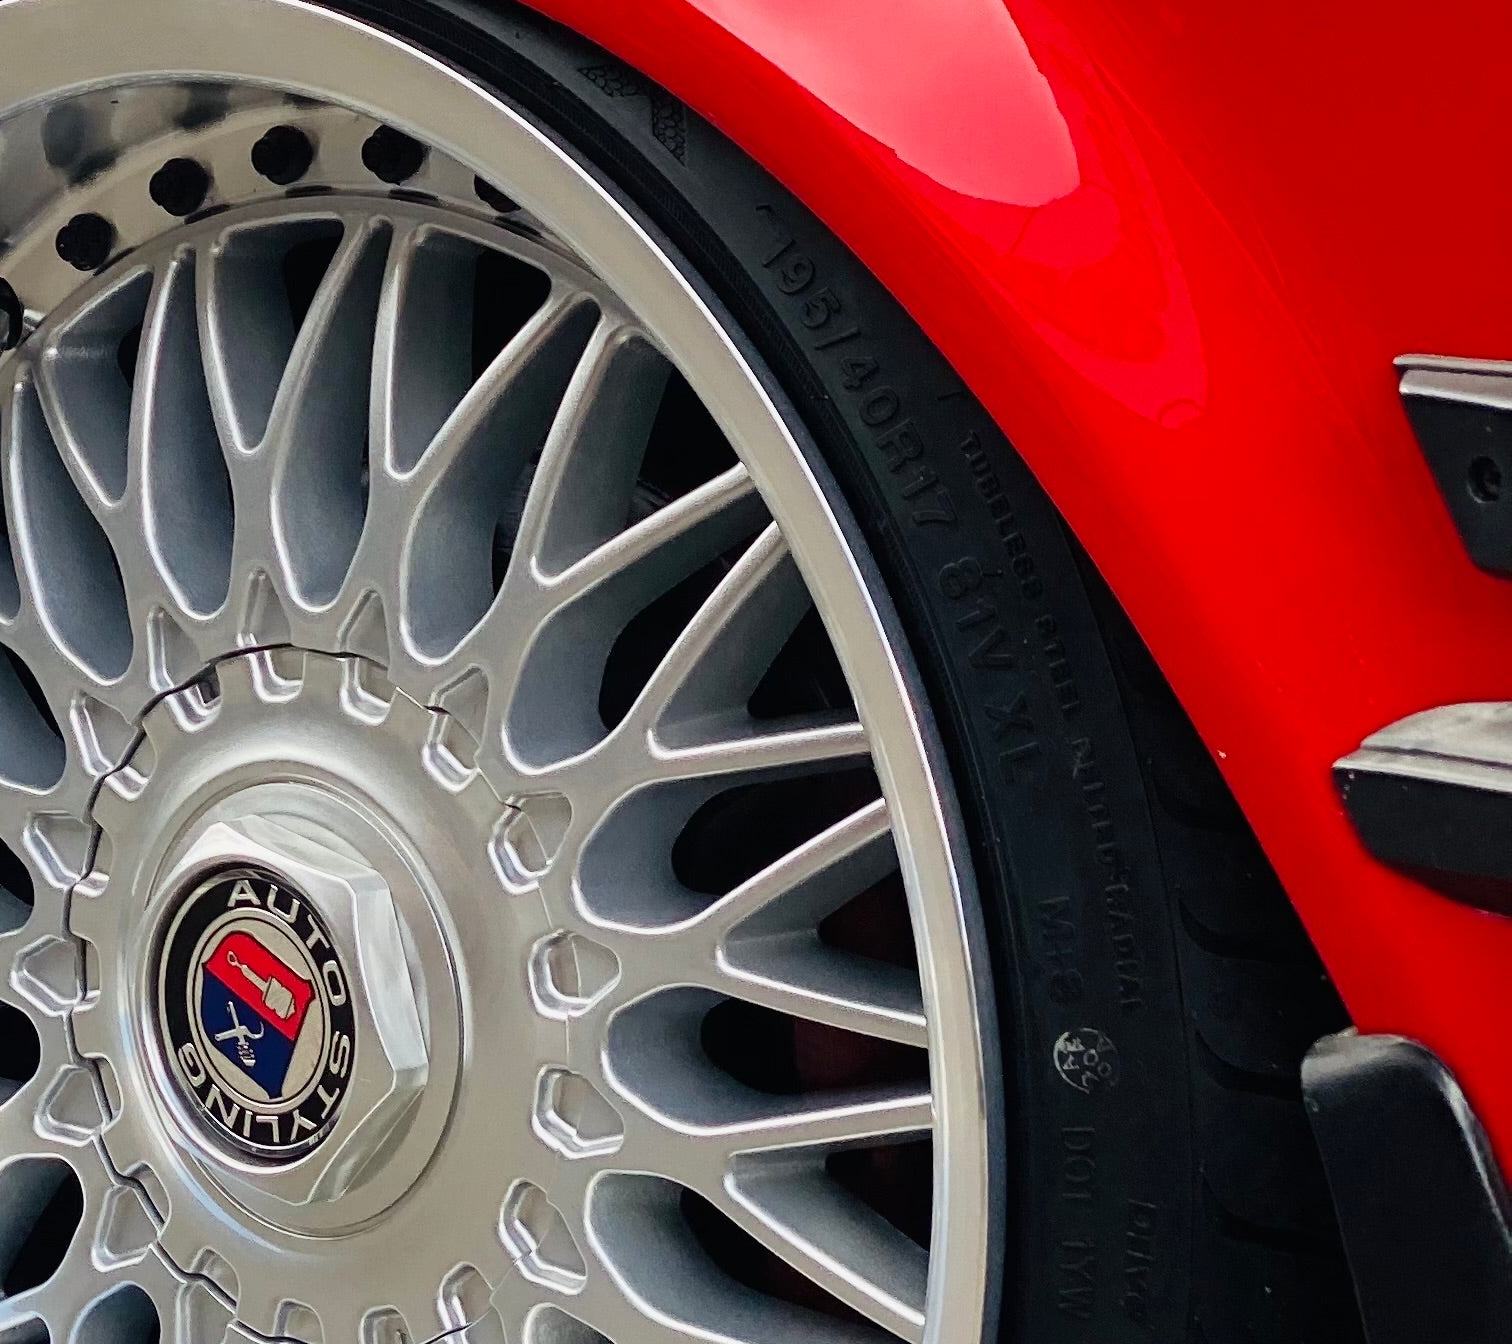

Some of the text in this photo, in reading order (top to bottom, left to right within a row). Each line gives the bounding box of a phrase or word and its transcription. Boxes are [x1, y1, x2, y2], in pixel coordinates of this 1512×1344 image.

[760, 238, 960, 534] 195/40R17
[178, 879, 348, 1143] AUTO STYLING
